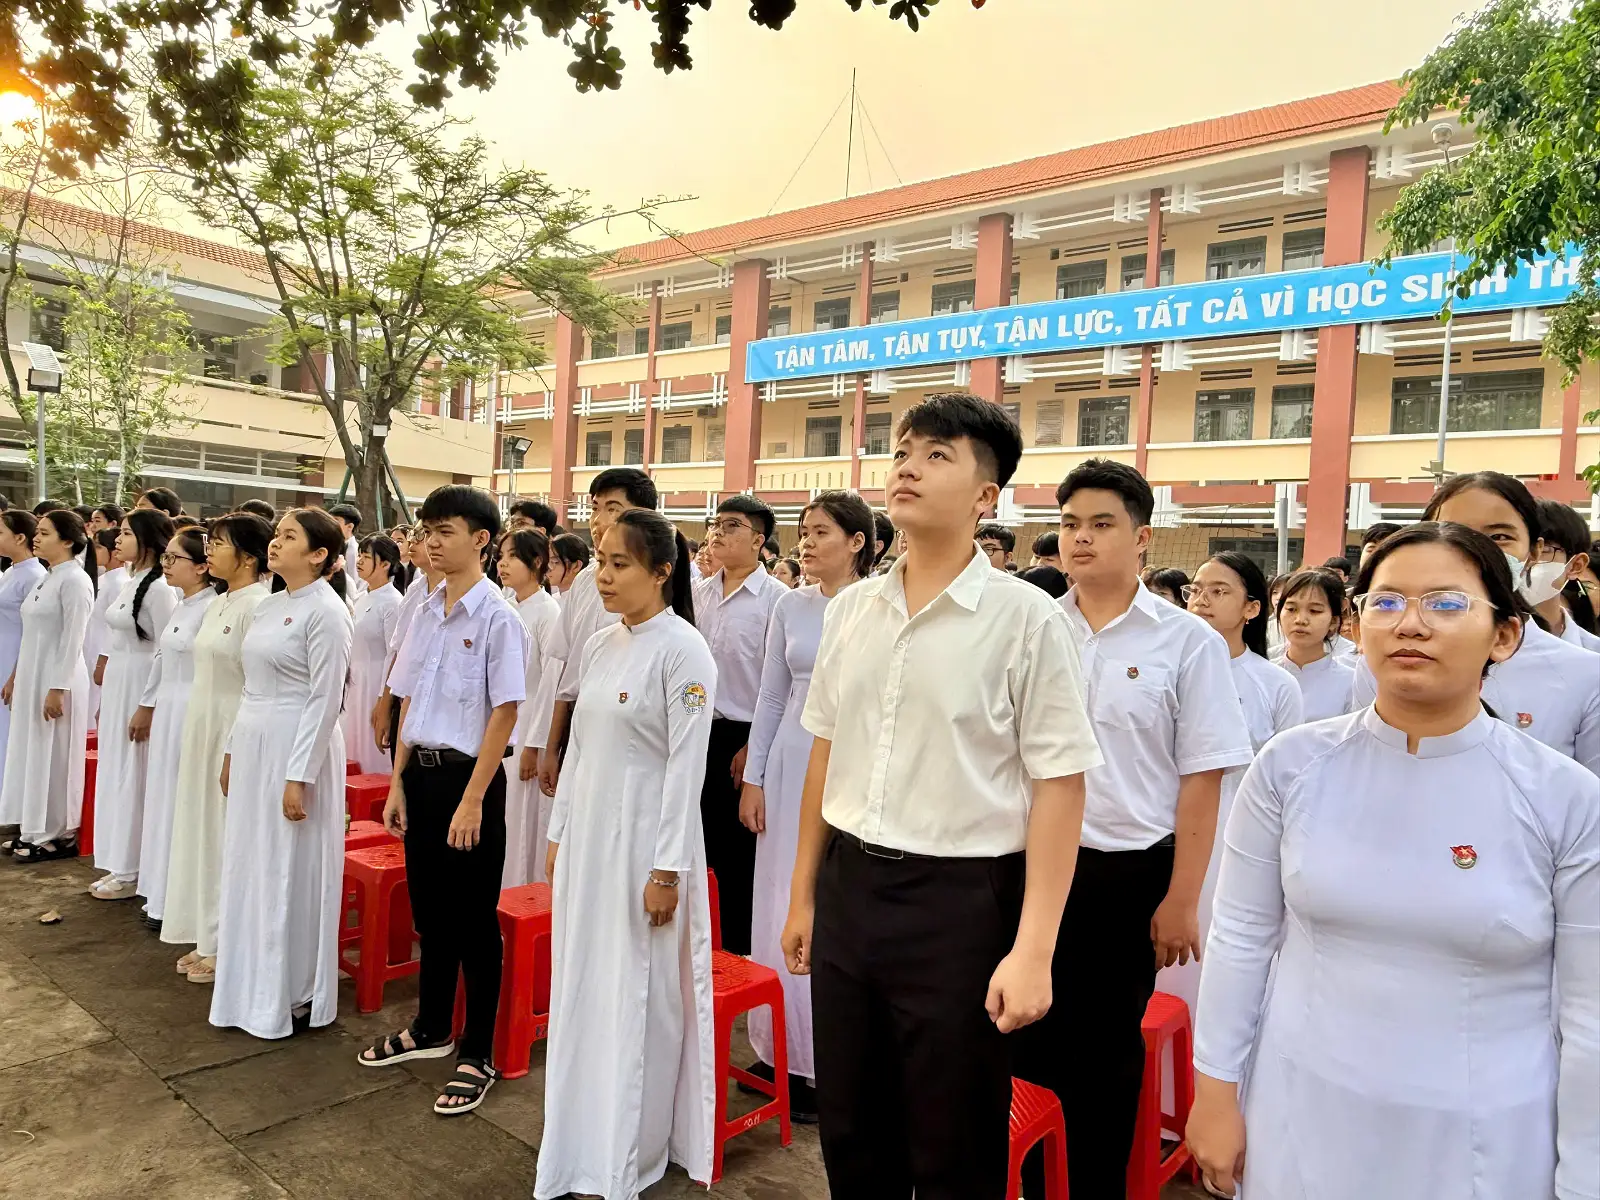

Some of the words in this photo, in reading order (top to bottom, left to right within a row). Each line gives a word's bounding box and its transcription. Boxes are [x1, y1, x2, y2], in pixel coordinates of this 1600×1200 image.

[774, 345, 816, 373] TẬN
[821, 338, 876, 365] TÂM,
[882, 330, 930, 360] TẬN
[937, 324, 986, 354] TỤY,
[993, 315, 1049, 347] TẬN
[1057, 309, 1123, 341] LỰC,
[1133, 294, 1192, 330] TẤT
[1202, 287, 1249, 324] CẢ
[1260, 284, 1296, 318] VÌ
[1307, 279, 1388, 315] HỌC
